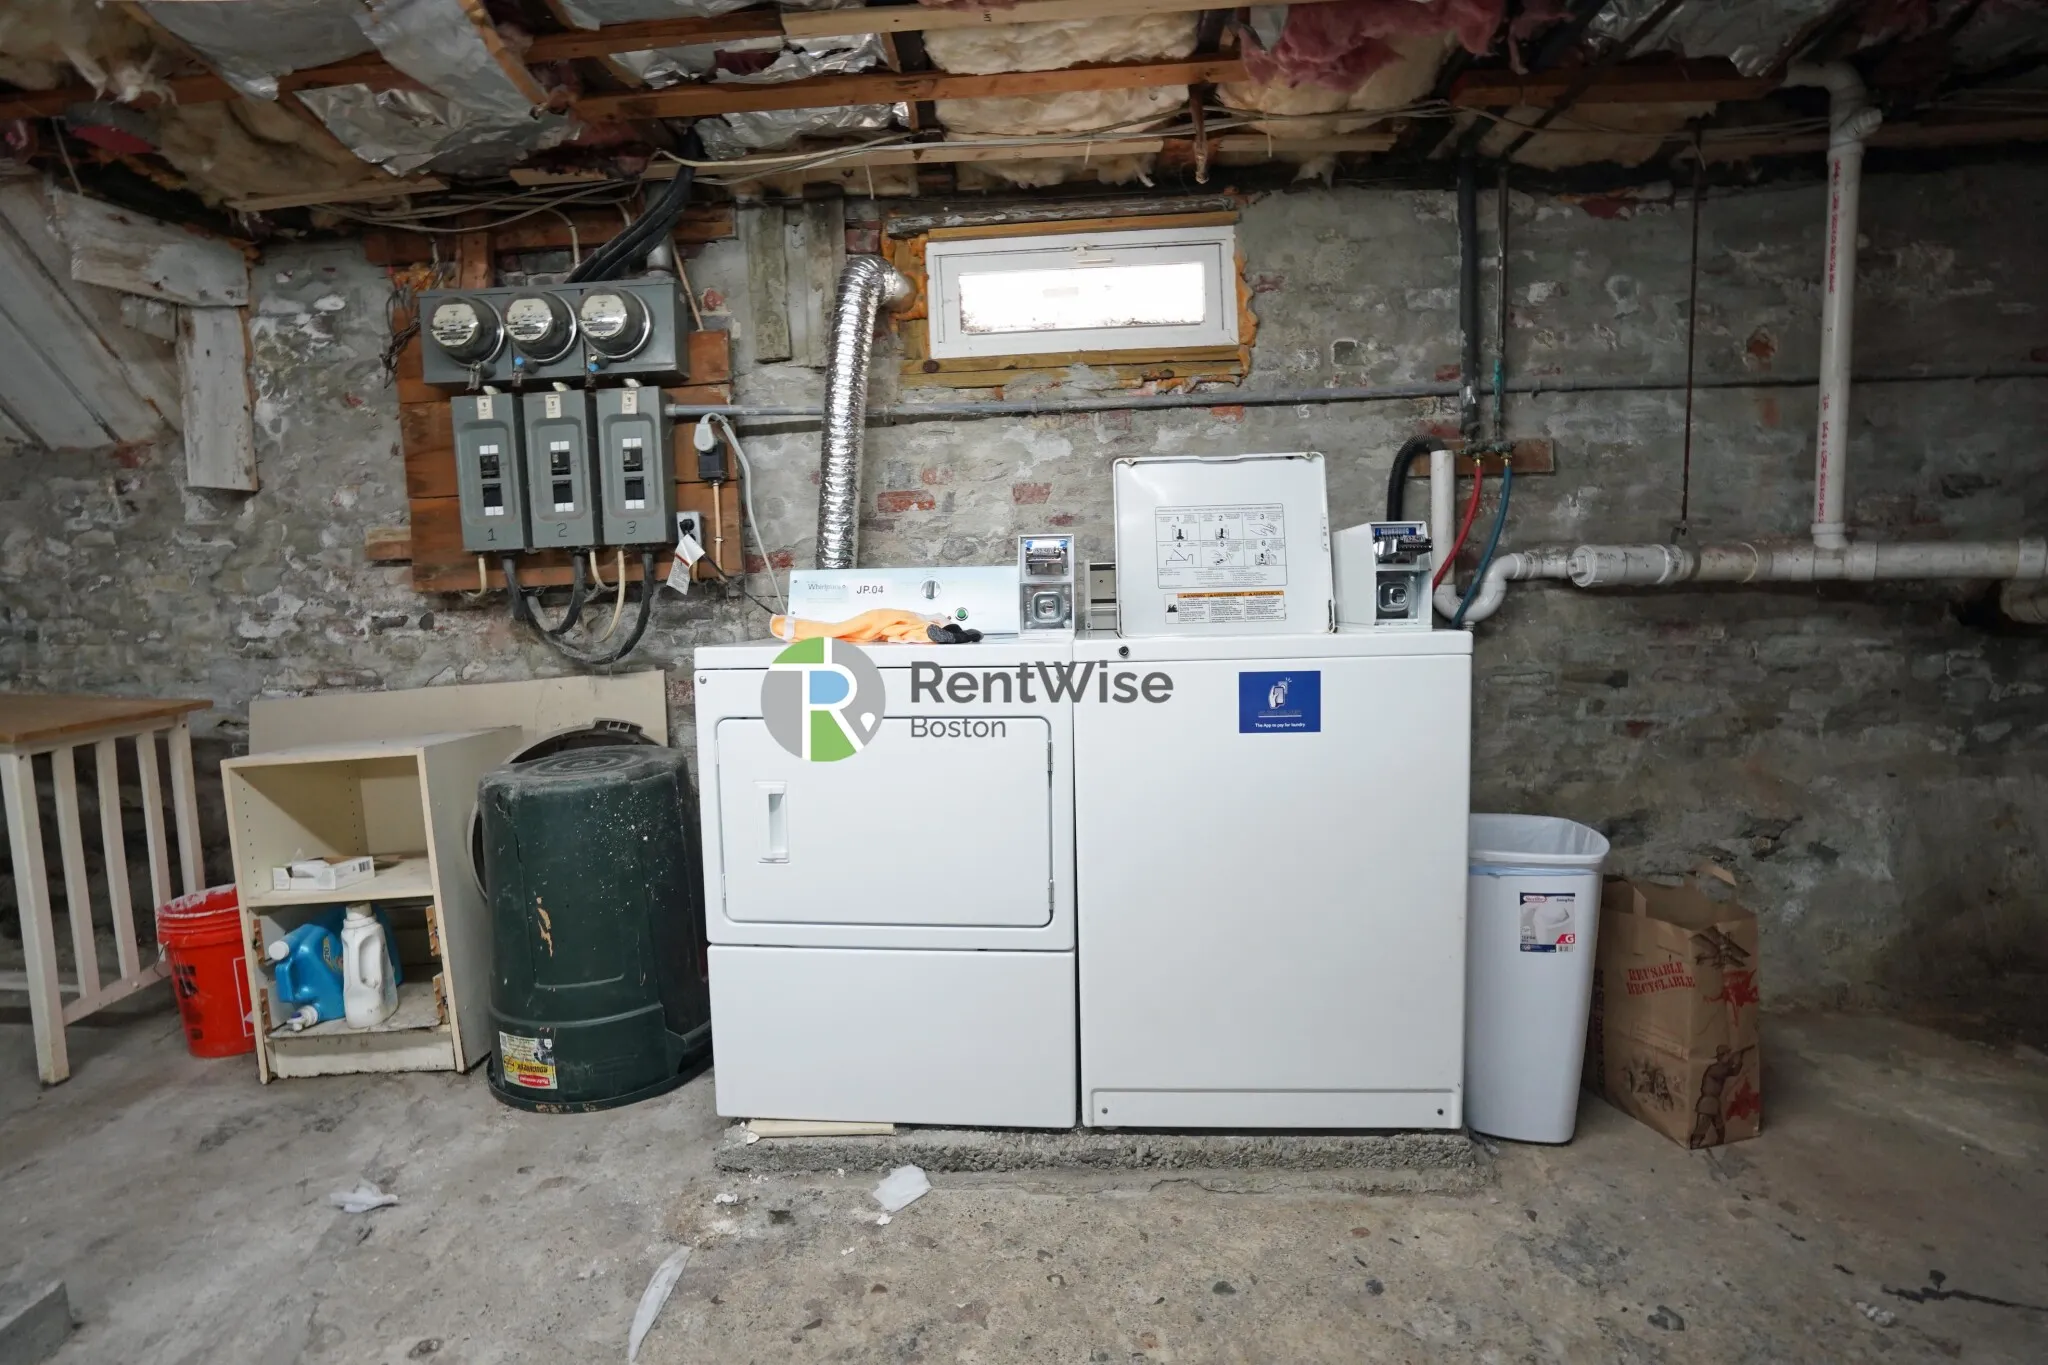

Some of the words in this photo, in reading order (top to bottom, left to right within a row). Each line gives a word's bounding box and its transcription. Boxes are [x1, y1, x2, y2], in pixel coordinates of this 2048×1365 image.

[486, 527, 497, 542] 1
[556, 522, 568, 538] 2
[626, 520, 638, 534] 3
[856, 585, 884, 595] JP.04
[1628, 961, 1684, 981] REUSABLE
[1626, 975, 1696, 996] RECYCLABLE
